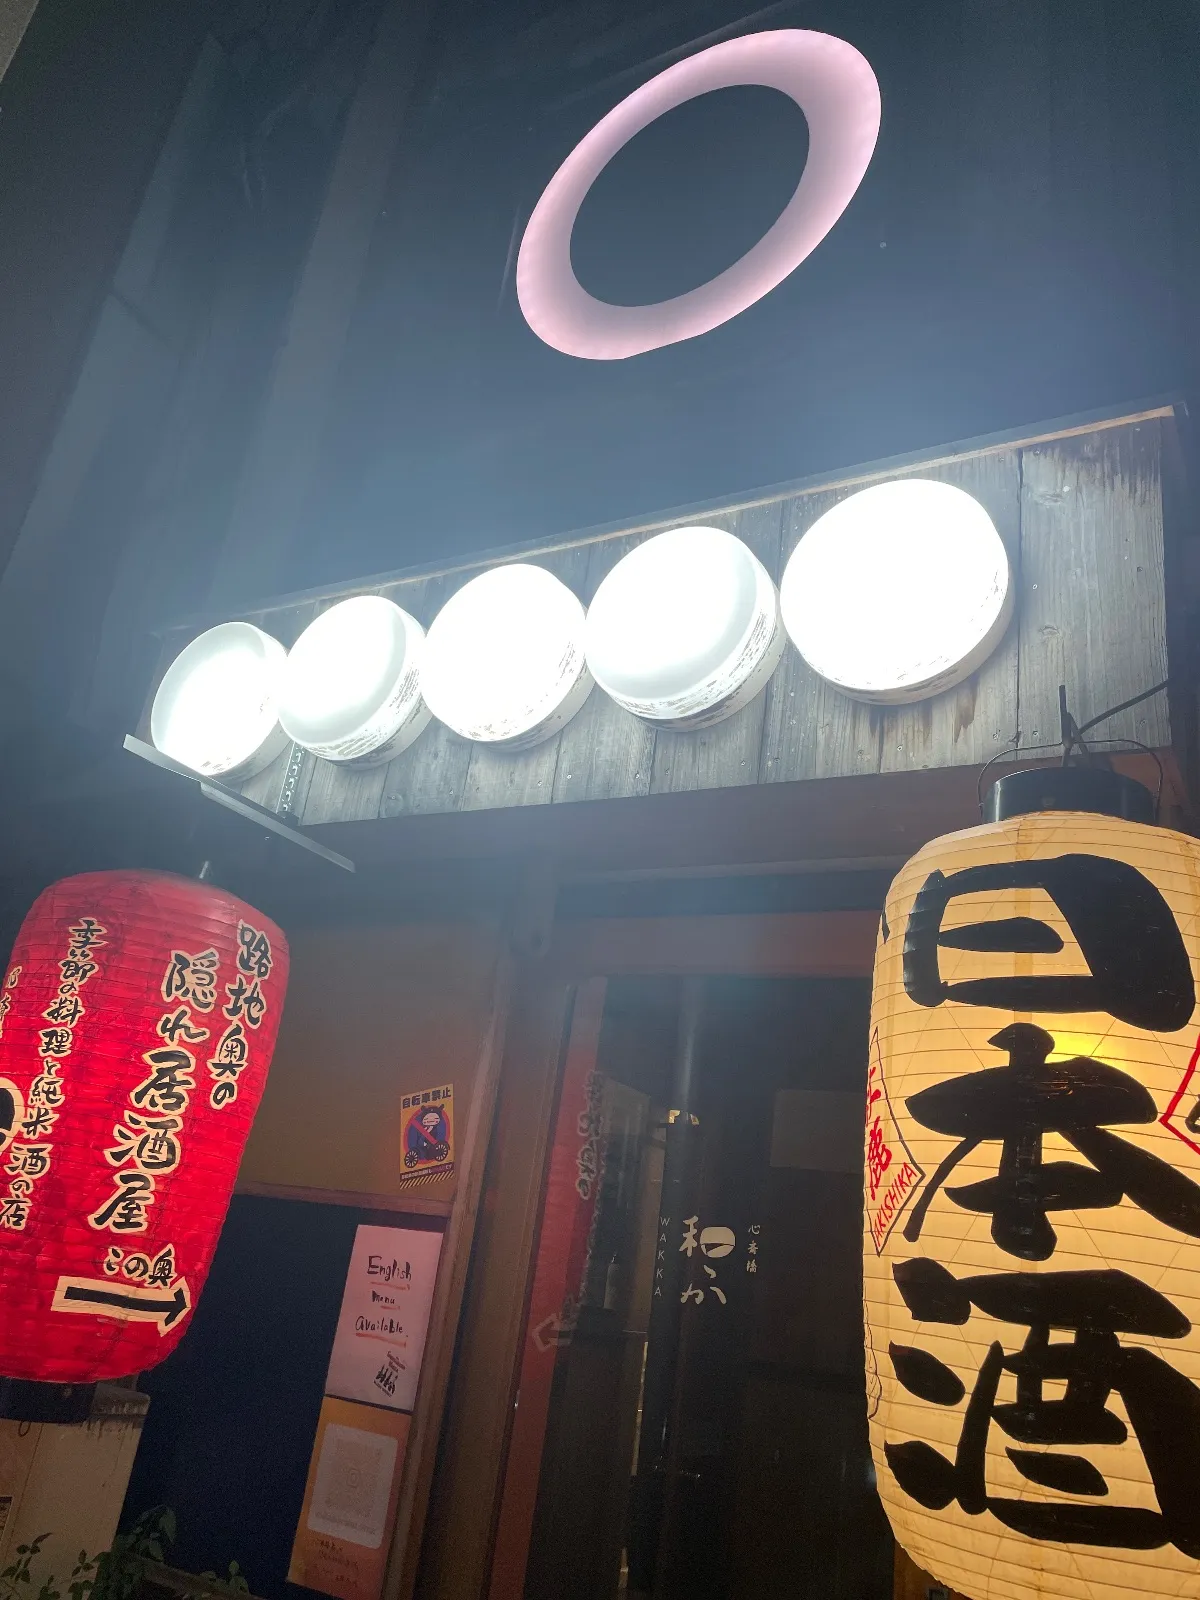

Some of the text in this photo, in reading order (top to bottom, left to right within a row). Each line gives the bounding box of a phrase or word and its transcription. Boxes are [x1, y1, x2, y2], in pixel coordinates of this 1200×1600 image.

[210, 919, 273, 1107] 路地奥の
[0, 918, 106, 1229] 季節の料理と純米酒の店
[92, 950, 219, 1231] 隠れ居酒屋
[402, 1086, 452, 1109] 自転車禁止
[872, 1161, 919, 1247] AKISHIKA
[884, 853, 1200, 1562] 日本酒
[105, 1245, 175, 1287] この奥
[366, 1255, 413, 1282] English
[653, 1216, 671, 1297] WAKKA
